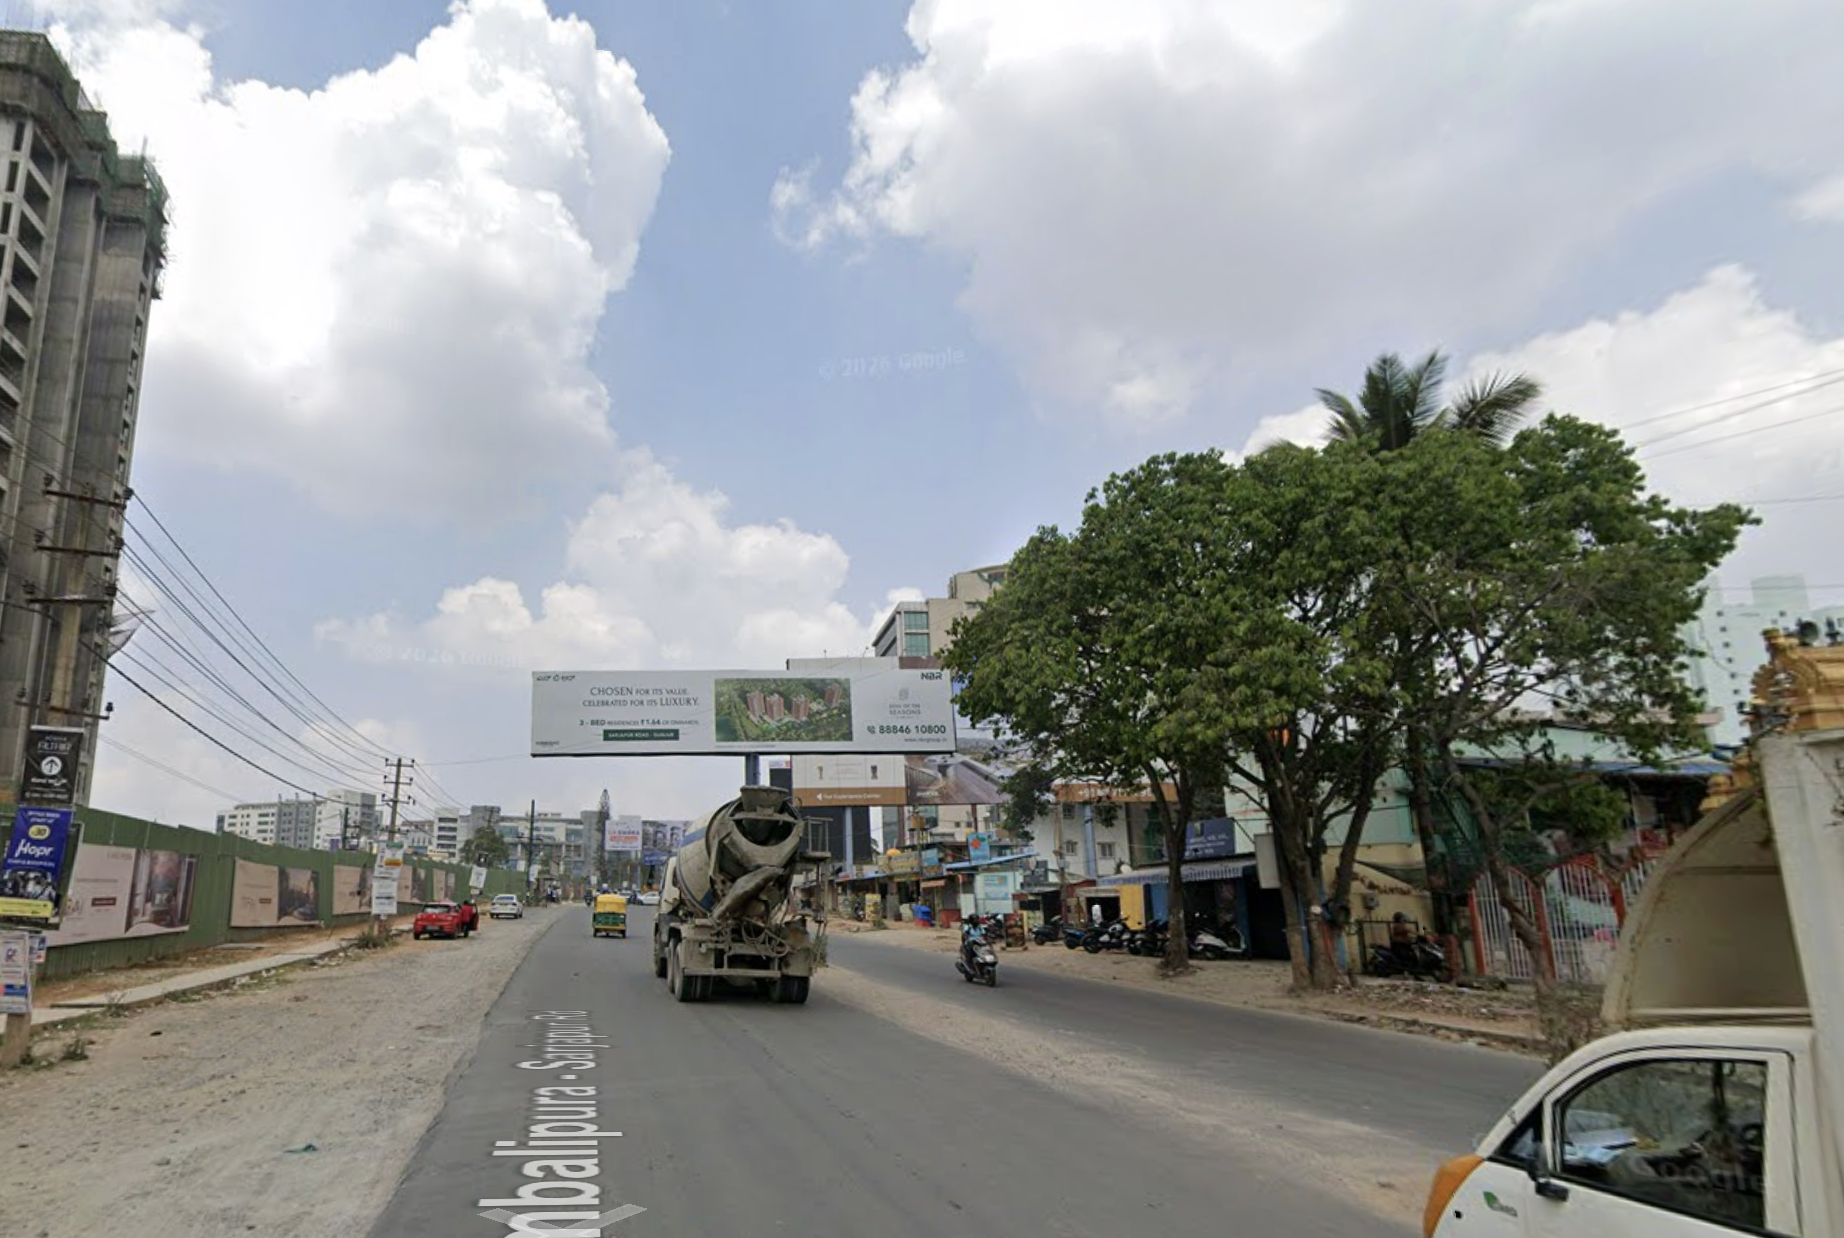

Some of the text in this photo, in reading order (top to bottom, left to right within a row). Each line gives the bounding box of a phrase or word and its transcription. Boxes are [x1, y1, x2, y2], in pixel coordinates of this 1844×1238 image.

[920, 672, 943, 681] NBR
[589, 686, 633, 697] CHOSEN
[635, 688, 651, 696] FOR
[582, 700, 629, 708] CELEBRATED
[879, 724, 947, 735] 88846 10800
